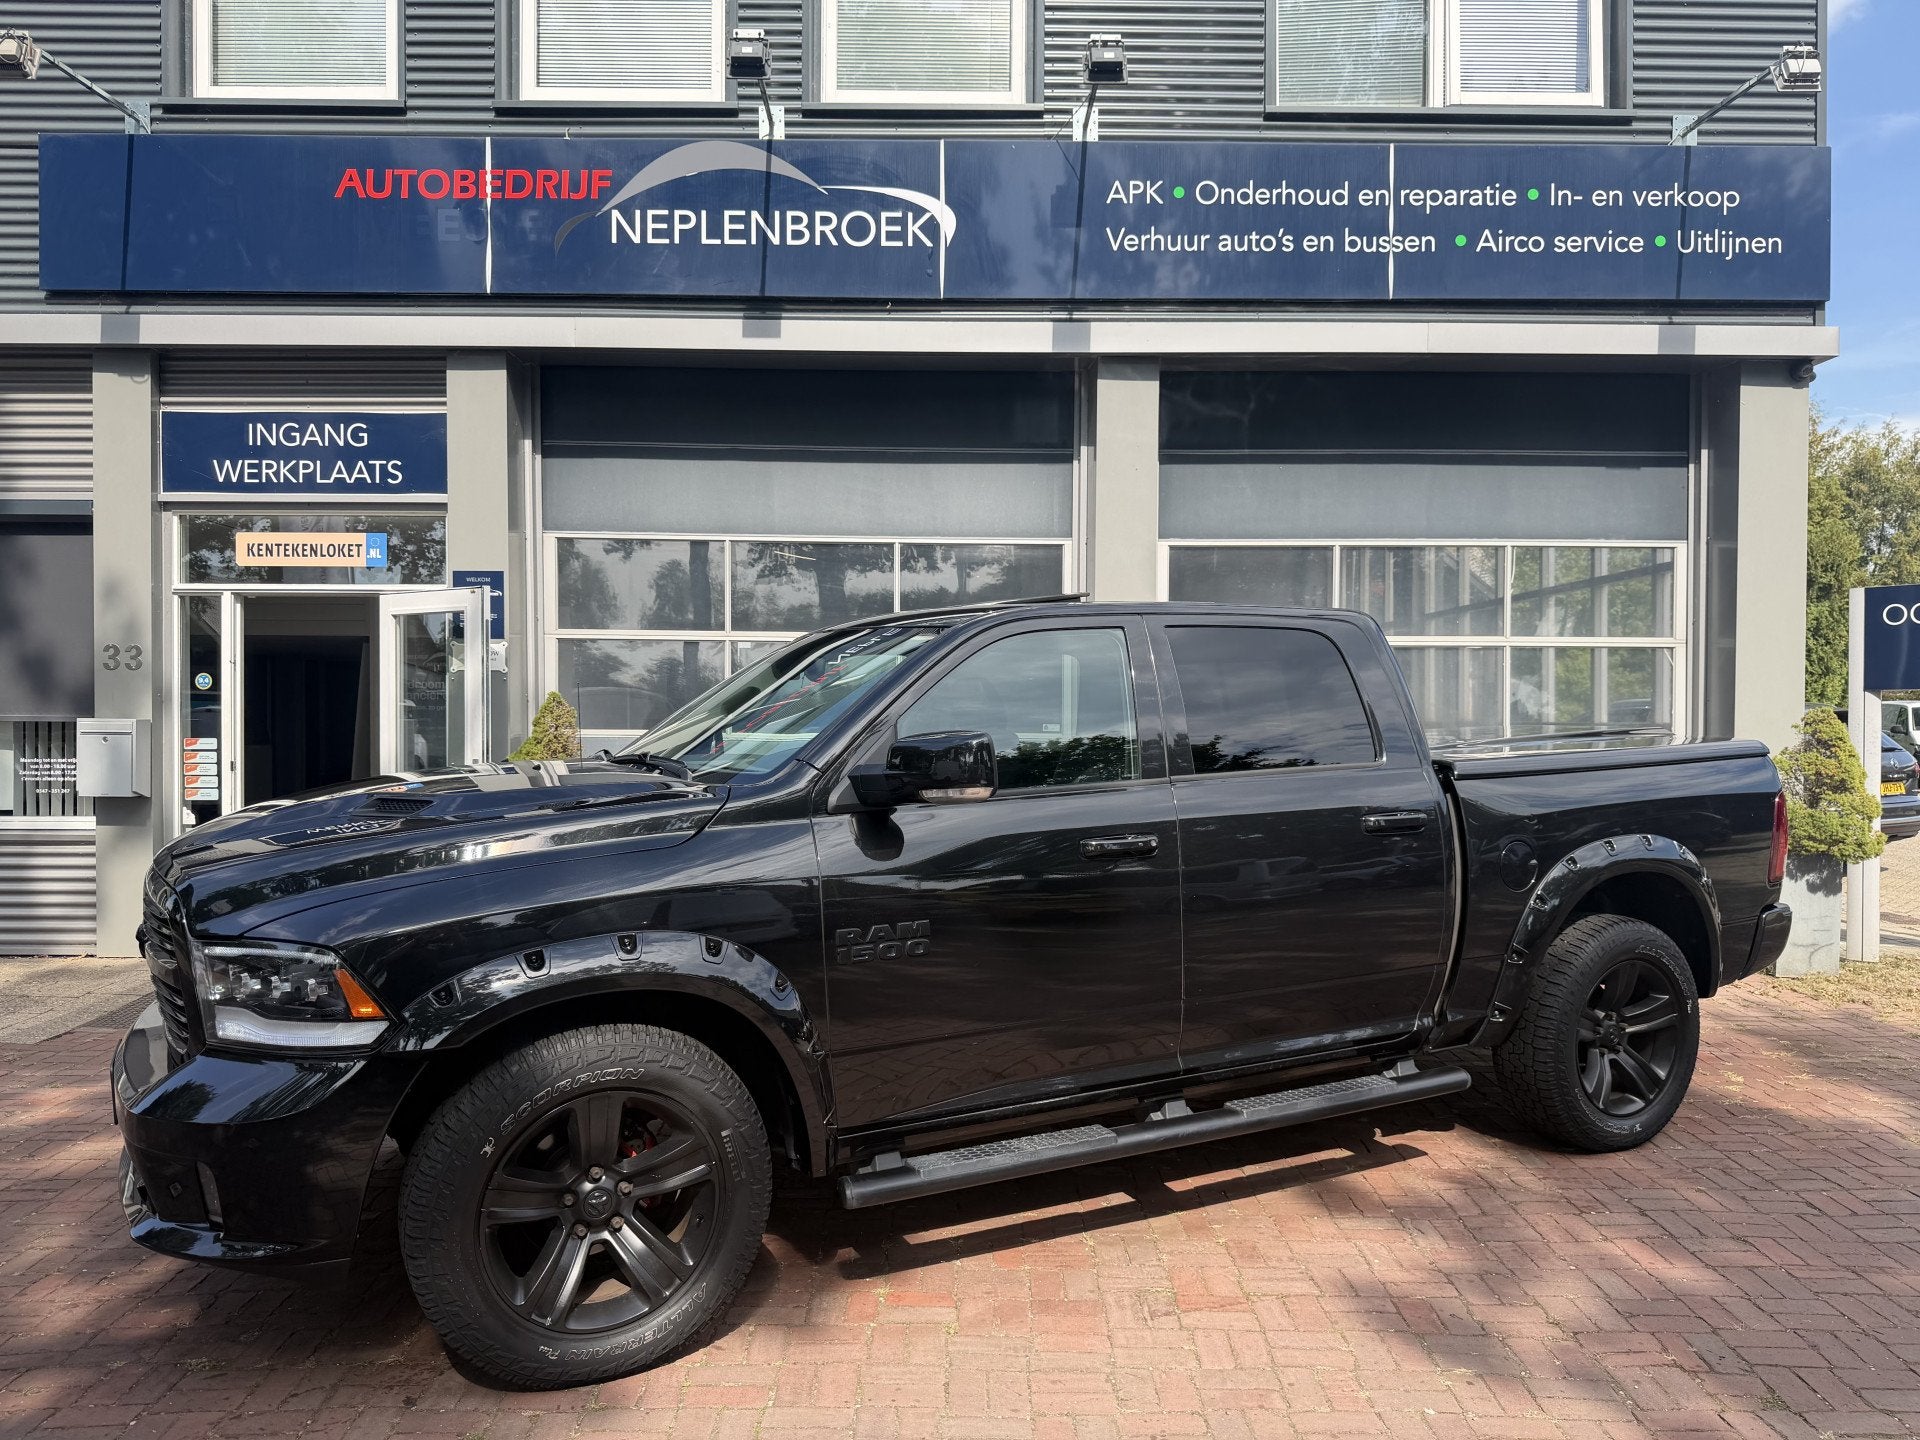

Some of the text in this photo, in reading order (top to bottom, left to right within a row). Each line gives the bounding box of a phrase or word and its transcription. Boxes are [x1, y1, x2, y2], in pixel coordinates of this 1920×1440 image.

[335, 168, 613, 200] AUTOBEDRIJF
[1106, 179, 1741, 215] APK Onderhoud en reparatie In- en verkoop
[610, 209, 934, 247] NEPLENBROEK
[1105, 227, 1782, 261] Verhuur auto's en bussen Airco service Uitlijnen
[247, 422, 369, 448] INGANG
[212, 459, 404, 485] WERKPLAATS
[102, 643, 143, 671] 33
[835, 919, 931, 946] RAM
[836, 938, 931, 965] 1500
[500, 1067, 645, 1136] SCORPION
